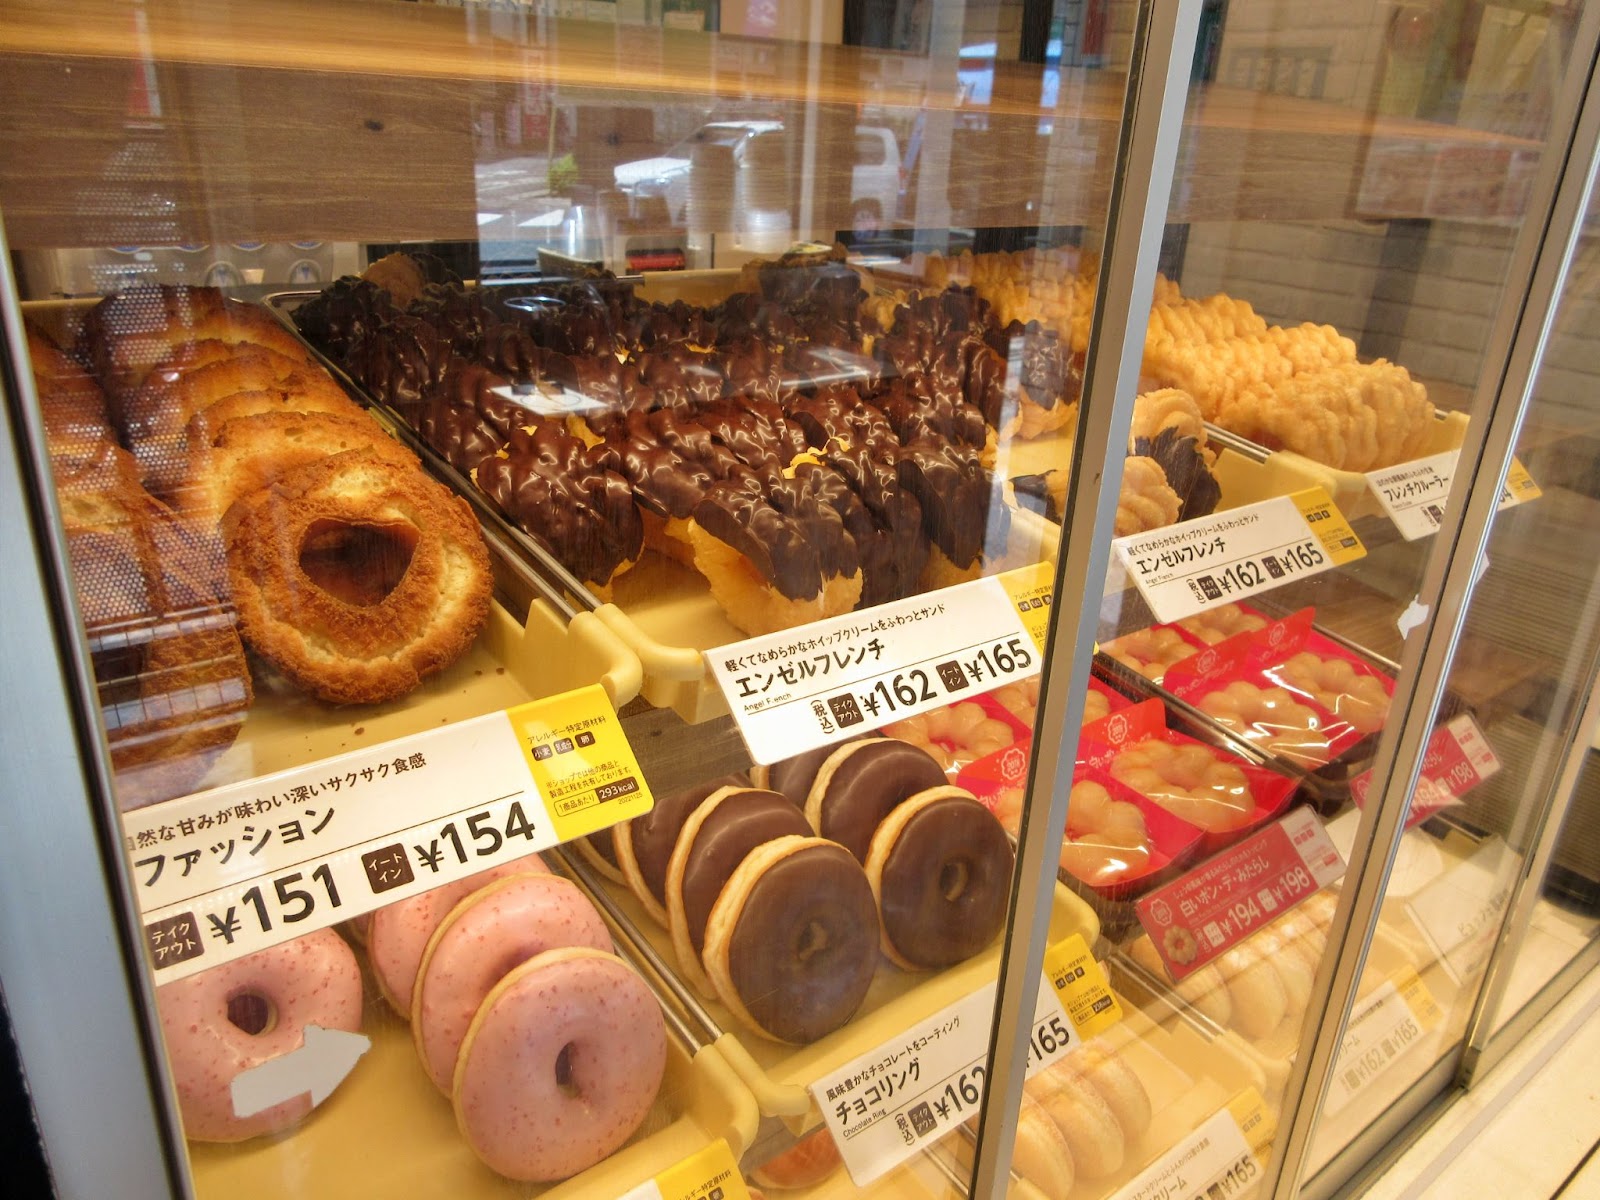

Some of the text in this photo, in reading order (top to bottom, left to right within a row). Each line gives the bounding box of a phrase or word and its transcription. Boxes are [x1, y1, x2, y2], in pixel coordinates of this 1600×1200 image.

[1136, 536, 1225, 575] エンゼルフレンチ
[1279, 542, 1324, 573] ¥165
[1217, 561, 1267, 593] ¥162
[725, 603, 947, 673] 軽くてなめらかなホイップクリームをふわっとサンド
[736, 638, 885, 698] エンゼルフレンチ
[941, 665, 960, 678] イート
[964, 638, 1032, 683] ¥165
[860, 669, 938, 717] ¥162
[949, 677, 961, 687] イン
[744, 692, 792, 711] Angel Fench
[833, 699, 853, 713] テイク
[838, 709, 859, 723] アウト
[527, 714, 607, 745] アレルギー特定原材料
[598, 782, 636, 800] 293kcal
[133, 807, 335, 888] ファッション
[413, 801, 536, 873] ¥154
[368, 852, 403, 872] イート
[379, 868, 402, 883] イン
[1274, 866, 1310, 902] ¥198
[206, 863, 342, 945] ¥151
[1220, 897, 1261, 937] ¥194
[151, 922, 191, 945] テイク
[155, 937, 197, 960] アウト
[1026, 1017, 1070, 1068] 165
[826, 1015, 960, 1103] 風味豊かなチョコレートをコーティング
[835, 1057, 920, 1126] チョコリング
[843, 1108, 887, 1138] Chocolate Ring
[680, 1169, 732, 1200] ルギー特定原材料
